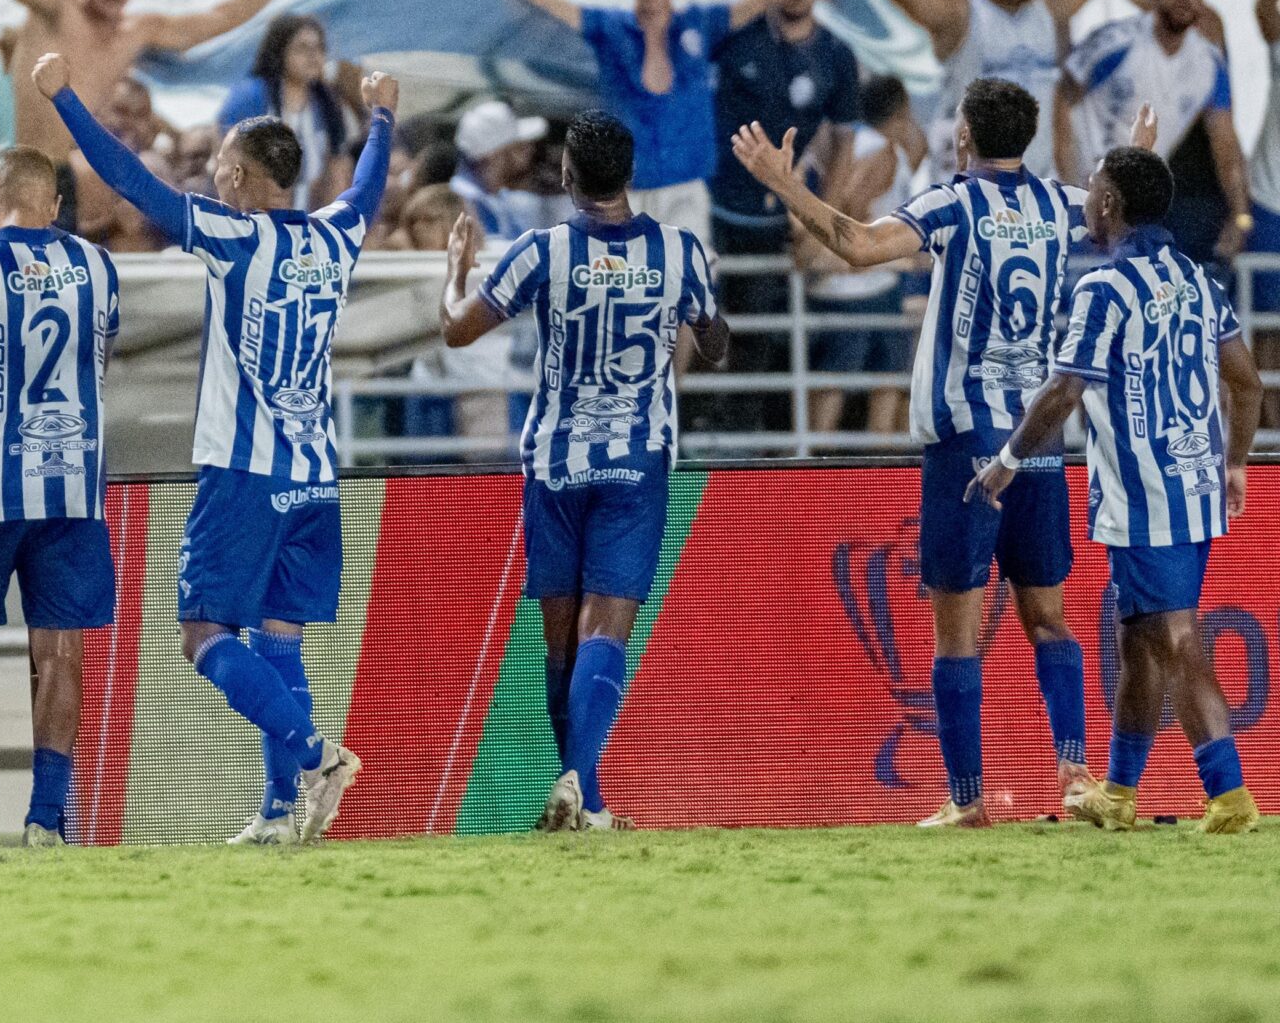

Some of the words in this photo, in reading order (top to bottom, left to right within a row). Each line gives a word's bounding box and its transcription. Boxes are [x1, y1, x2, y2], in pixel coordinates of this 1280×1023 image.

[978, 219, 1056, 245] Carajás
[10, 265, 87, 292] Carajás
[281, 261, 340, 286] Carajás
[573, 267, 661, 287] Carajás
[996, 255, 1041, 341] 6
[26, 304, 71, 404] 2
[263, 292, 339, 387] 17
[567, 299, 662, 386] 15
[1144, 317, 1210, 432] 18
[565, 468, 645, 485] UniCesumar
